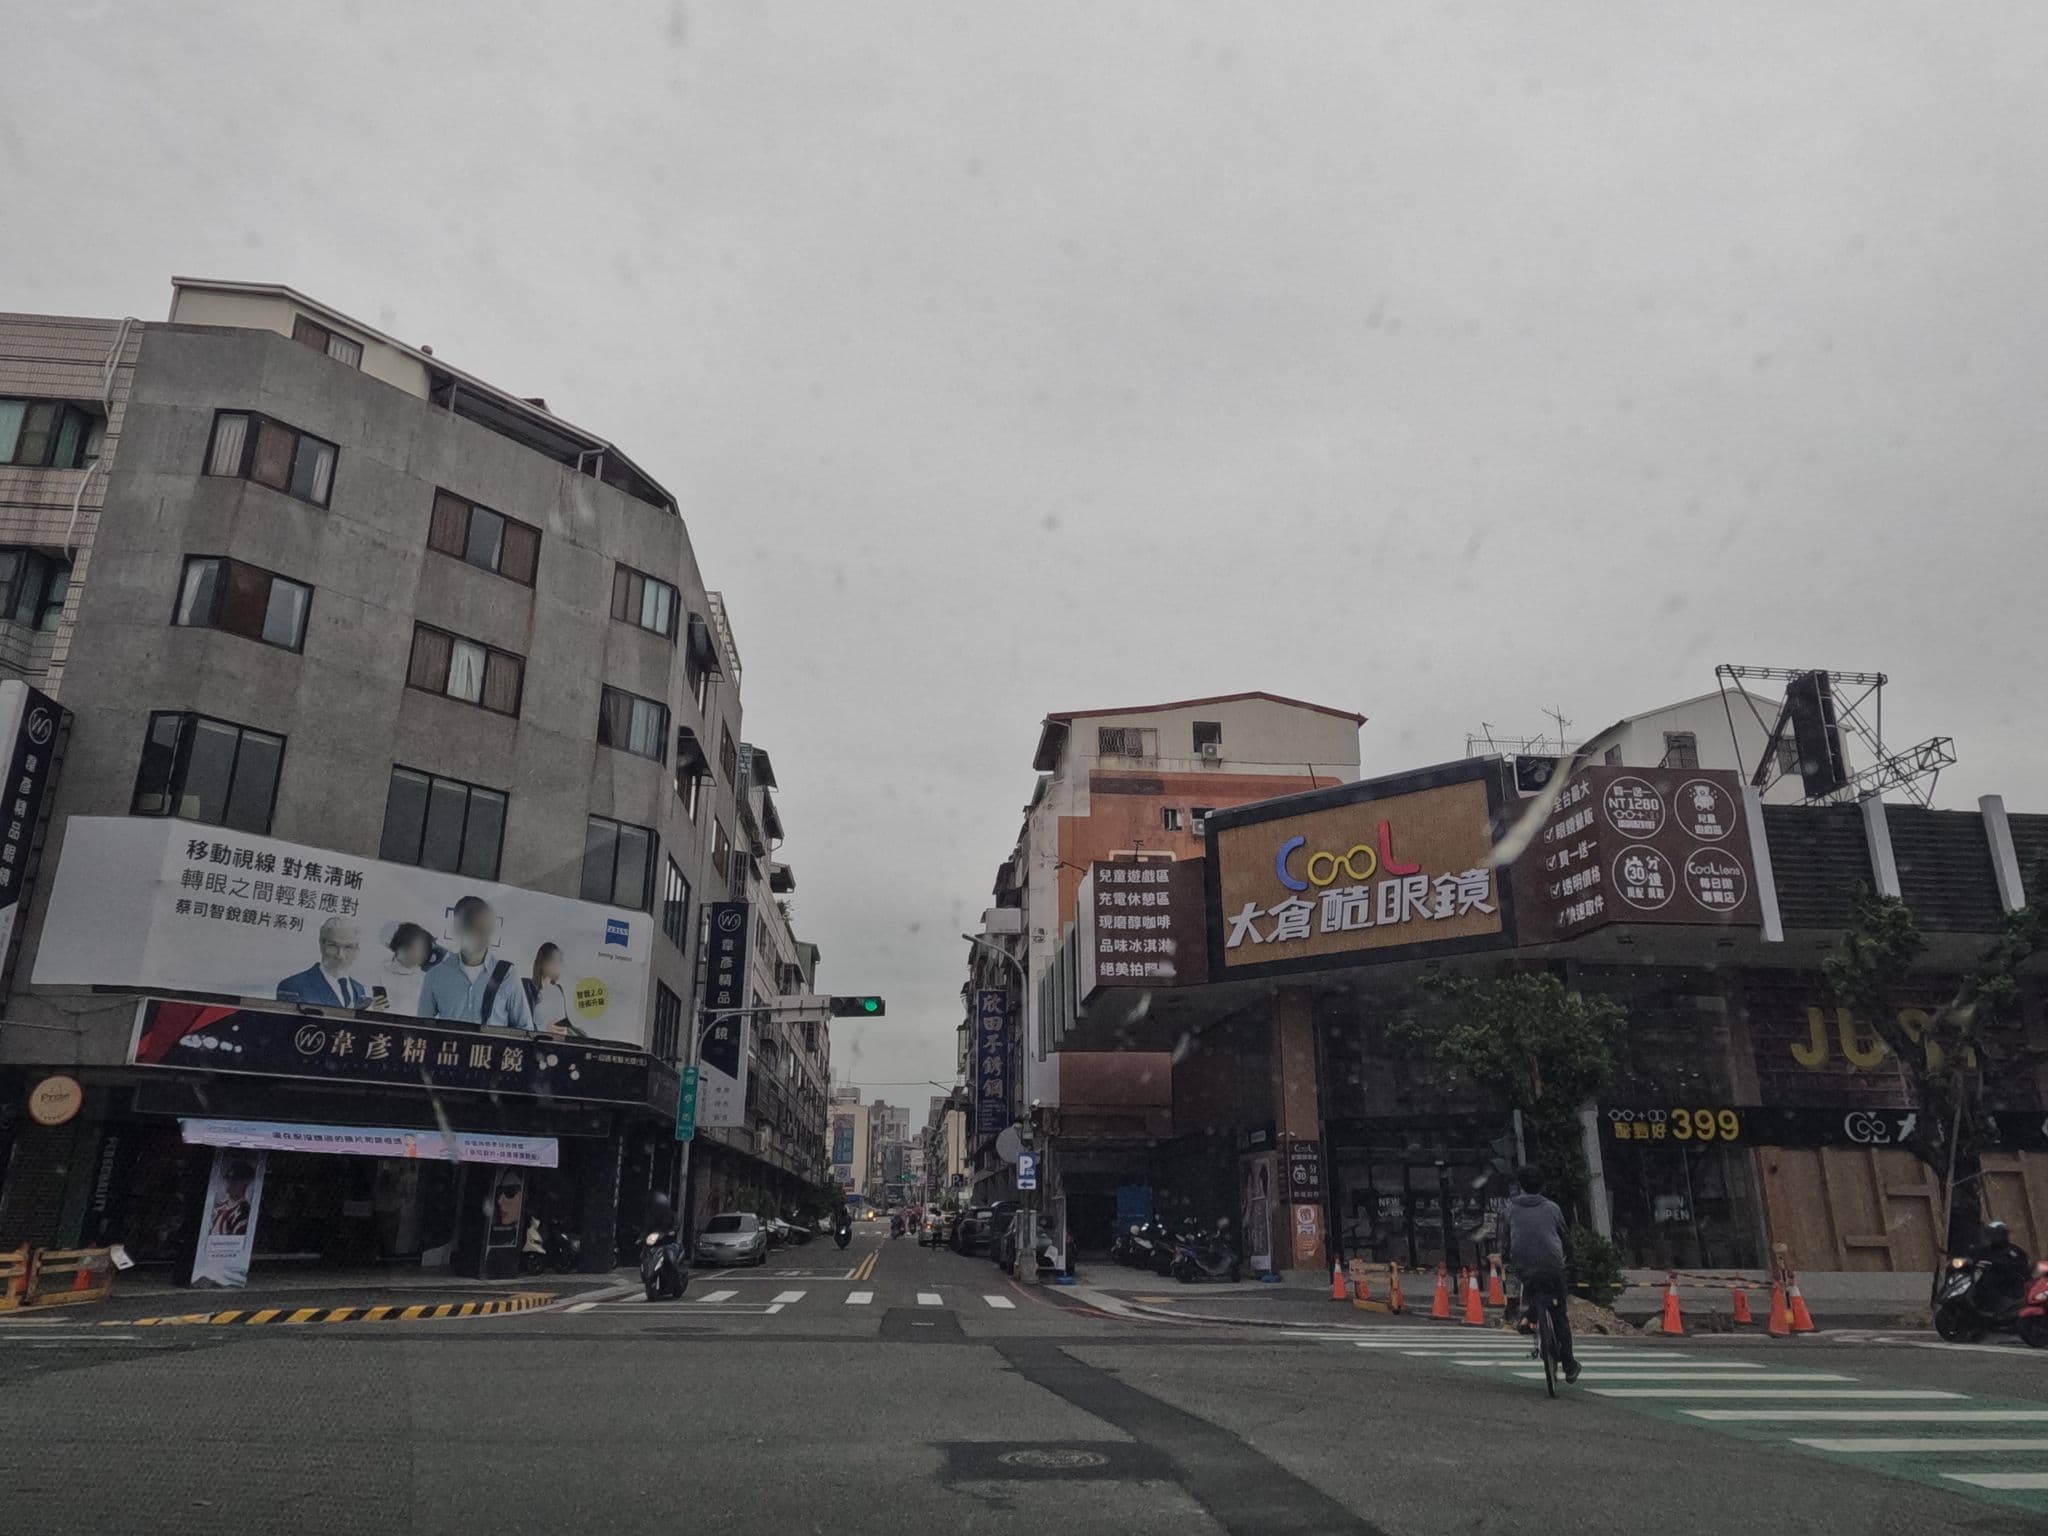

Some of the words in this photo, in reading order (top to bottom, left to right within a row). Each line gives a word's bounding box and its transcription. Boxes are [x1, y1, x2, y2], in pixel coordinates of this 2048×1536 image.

[185, 838, 277, 874] 移動視線
[281, 856, 364, 891] 對焦清晰
[1558, 840, 1598, 868] 買一送一
[1098, 868, 1170, 883] 兒童遊戲區
[1561, 865, 1601, 896] 透明價格
[1628, 866, 1645, 880] 30
[179, 866, 360, 917] 轉眼之間輕鬆應對
[1098, 891, 1171, 906] 充電休憩區
[174, 898, 304, 932] 蔡司智銳鏡片系列
[1098, 915, 1172, 930] 現磨醇咖啡
[1226, 867, 1498, 949] 大倉酷眼鏡
[1670, 1108, 1740, 1141] 399
[1019, 1155, 1034, 1176] P
